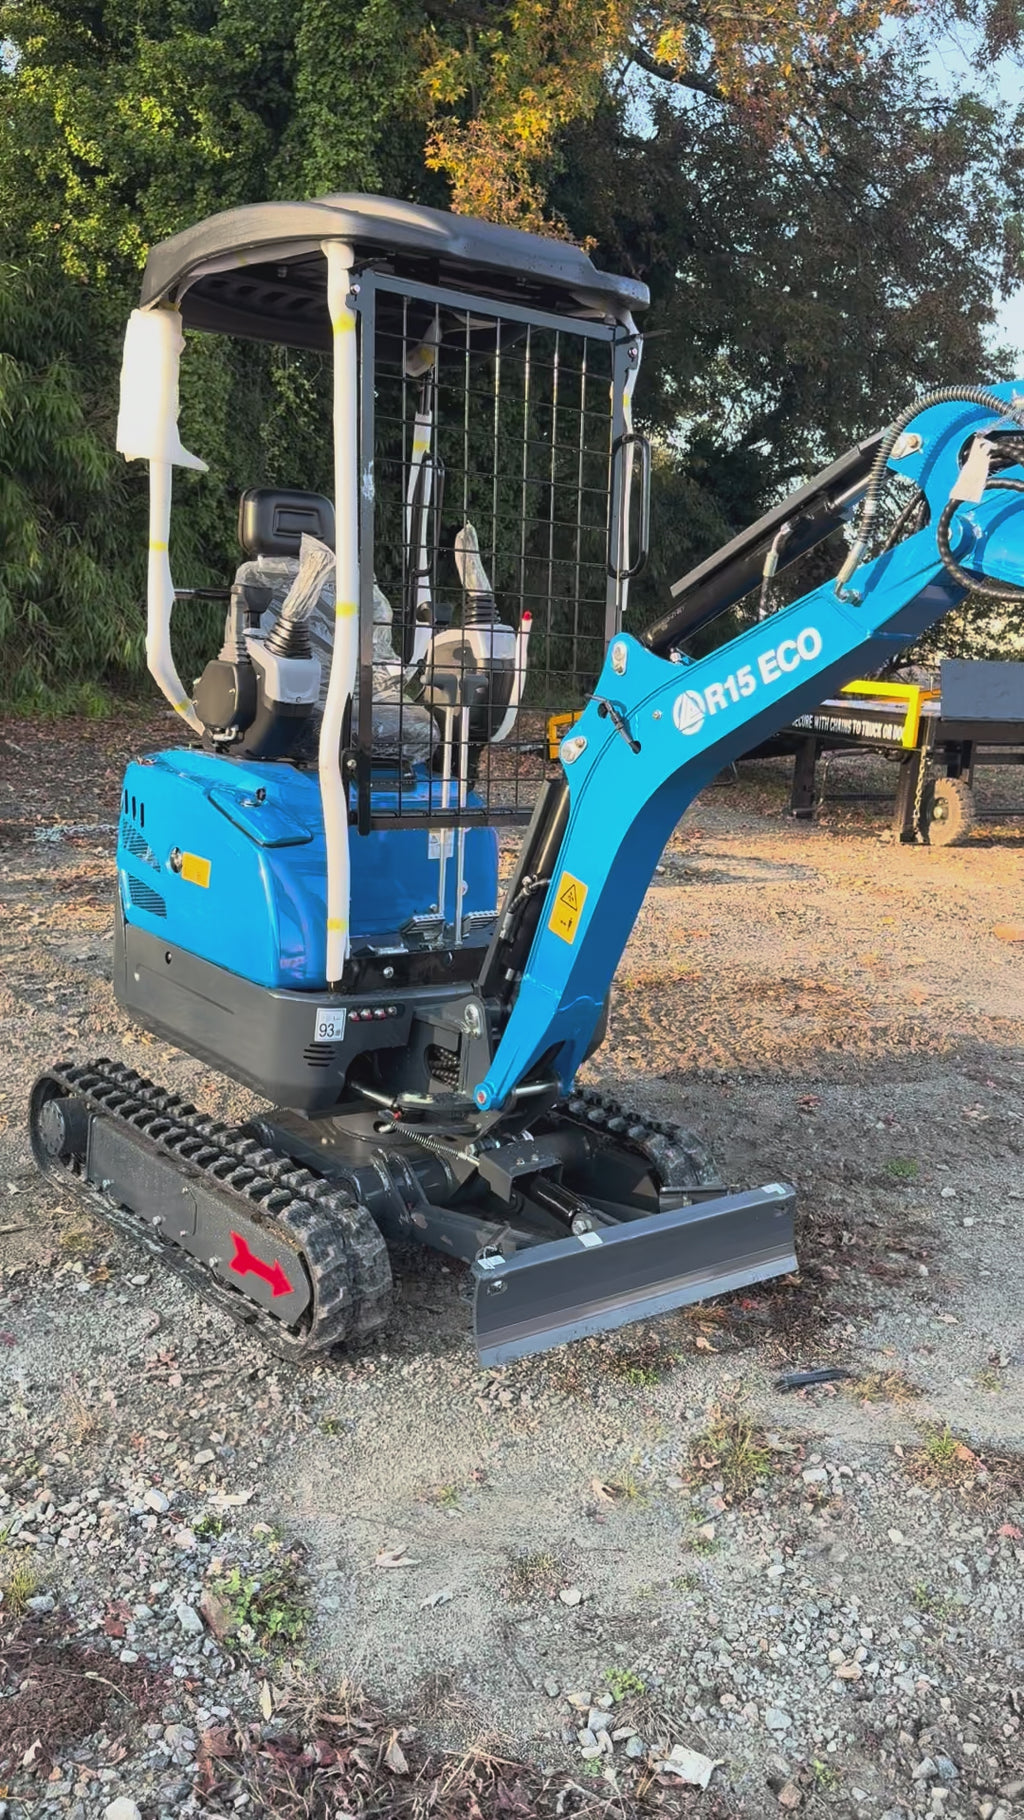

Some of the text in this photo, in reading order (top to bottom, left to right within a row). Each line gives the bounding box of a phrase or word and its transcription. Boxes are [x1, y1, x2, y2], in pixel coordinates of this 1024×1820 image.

[705, 627, 823, 715] R15 ECO
[814, 715, 830, 731] WITH
[830, 717, 852, 735] CHAINS
[852, 719, 861, 735] TO
[862, 721, 883, 738] TRUCK
[883, 724, 892, 740] OR
[319, 1023, 335, 1038] 93
